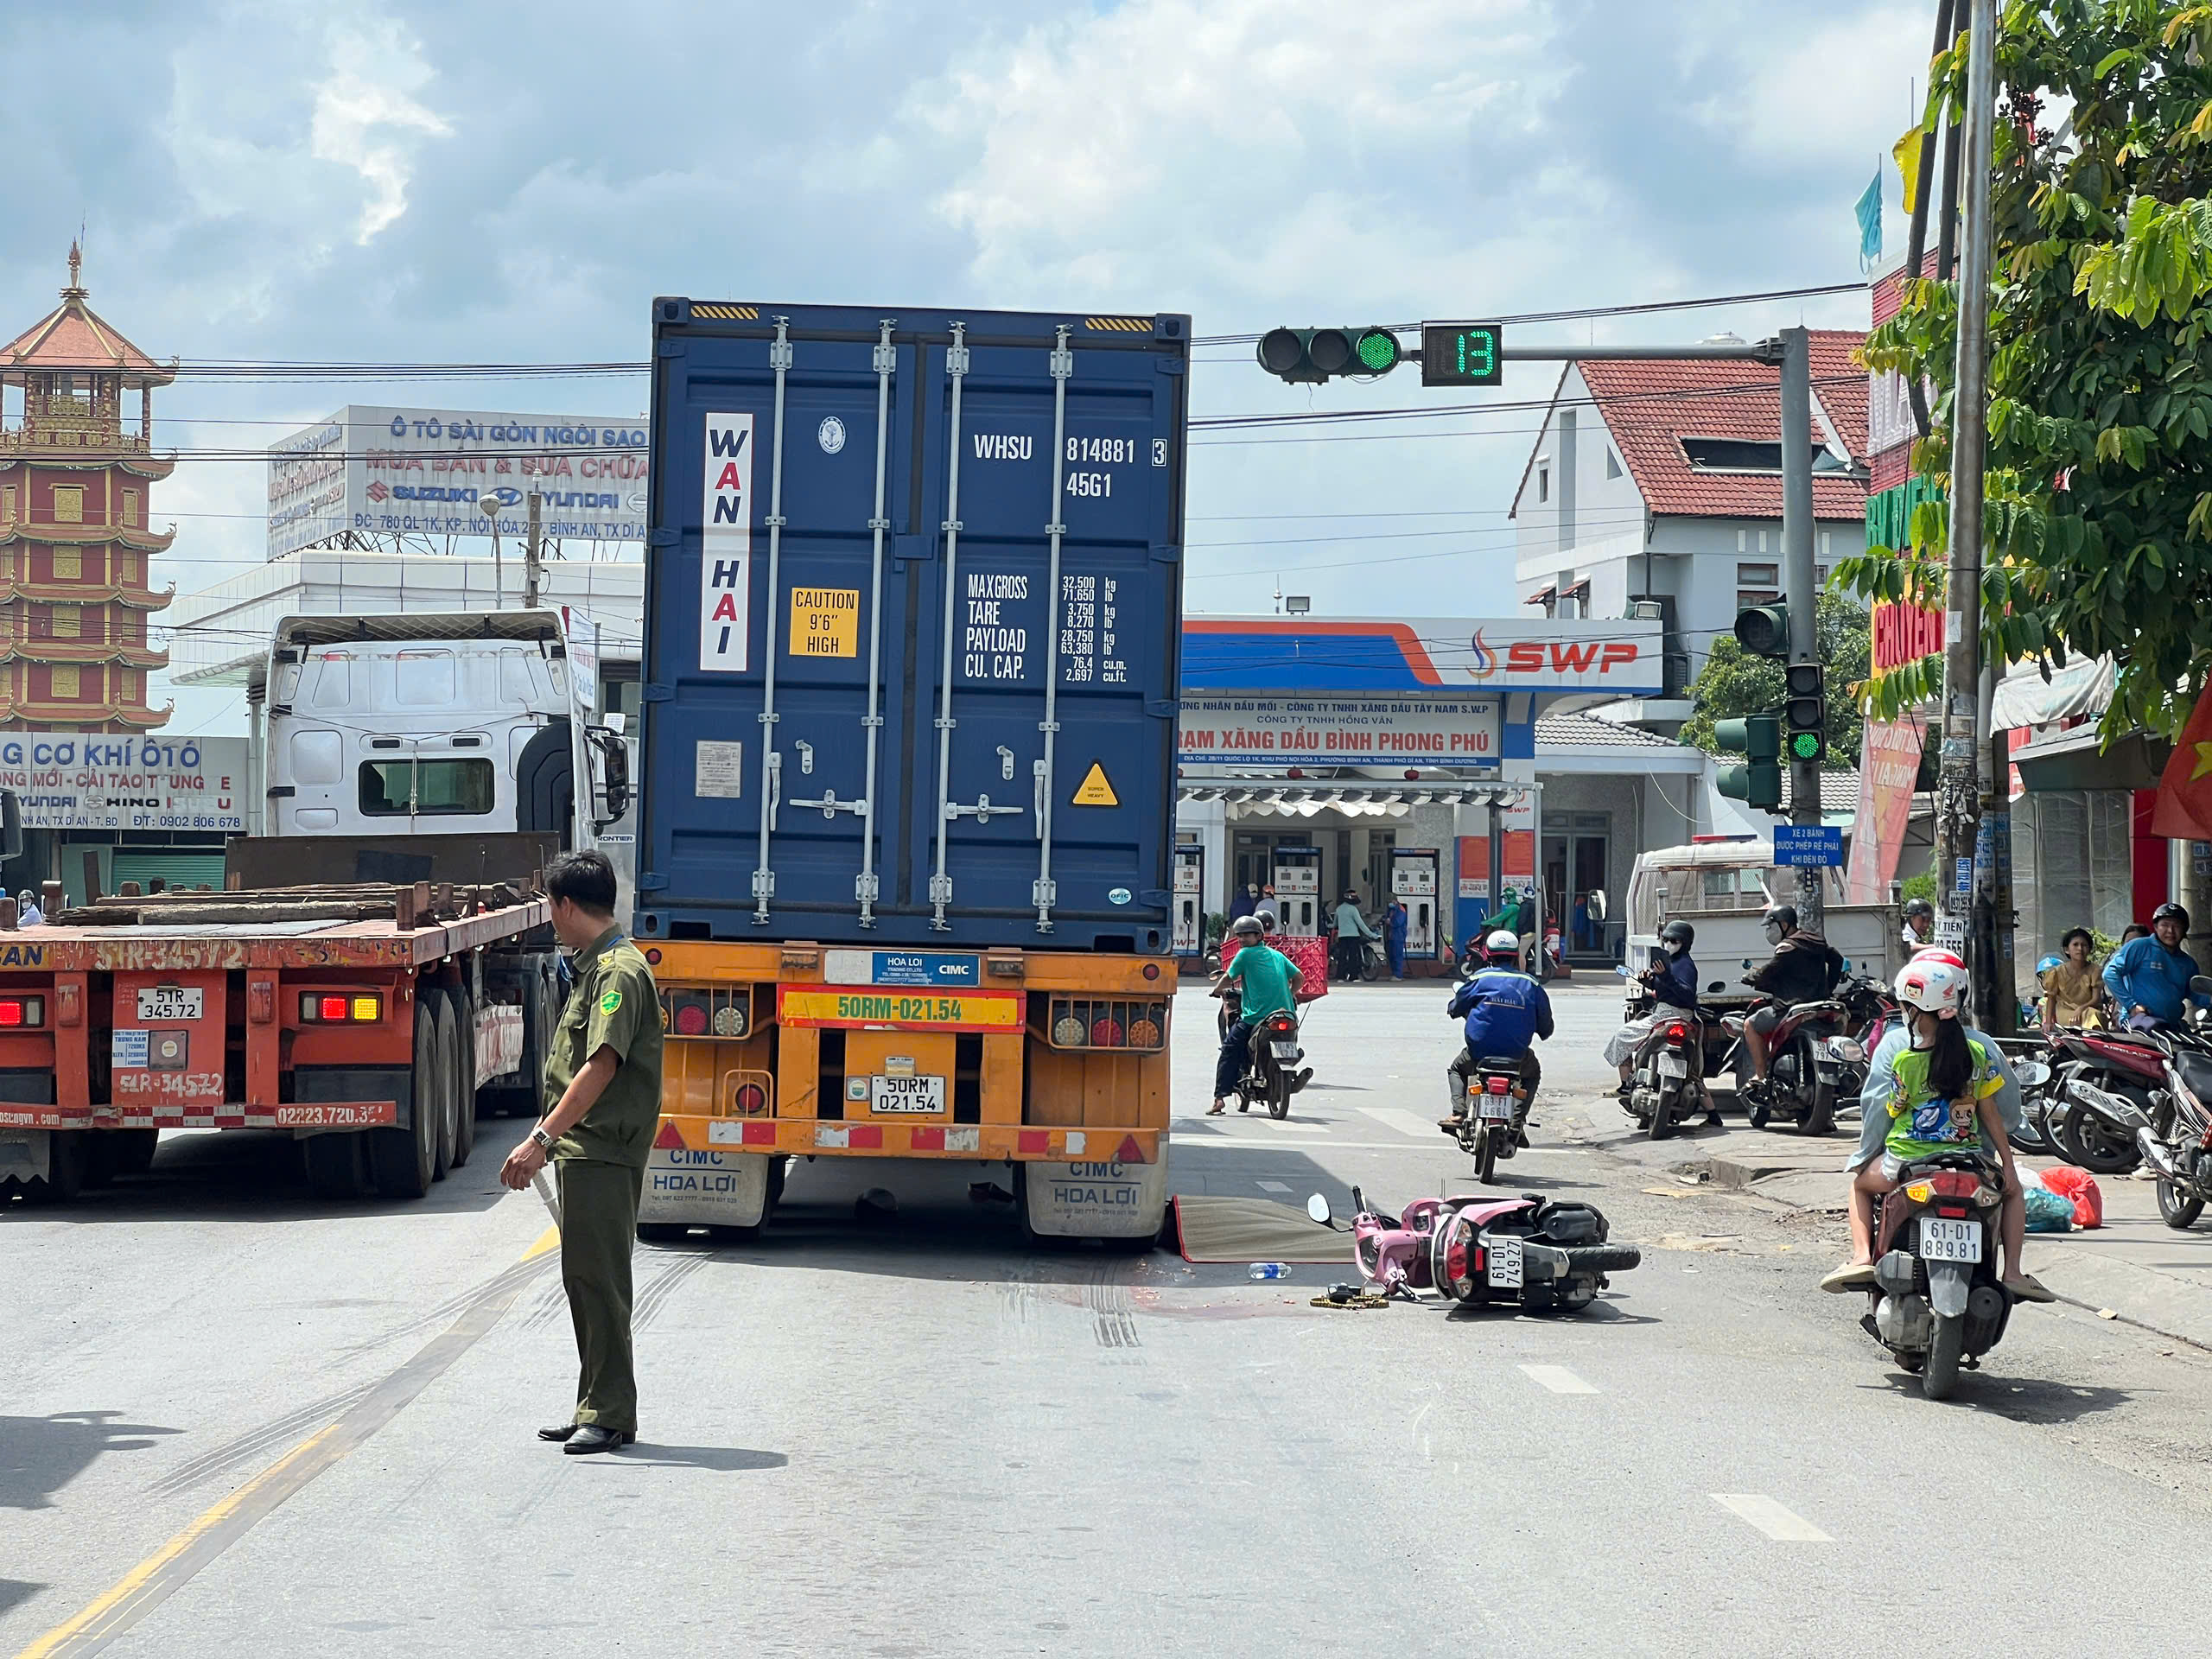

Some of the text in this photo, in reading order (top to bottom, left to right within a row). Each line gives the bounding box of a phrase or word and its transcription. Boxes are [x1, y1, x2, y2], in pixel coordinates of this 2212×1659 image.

[1457, 330, 1494, 377] 13
[391, 415, 646, 446] Ô TÔ SÀI GÒN NGÔI SAO
[973, 434, 1166, 465] WHSU 814881 3
[366, 448, 424, 470] MUA
[495, 454, 512, 474] &
[709, 428, 749, 524] WAN
[1066, 472, 1112, 499] 45G1
[392, 486, 620, 509] SUZUKI YUNDAI
[379, 516, 399, 529] 780
[404, 516, 420, 530] QL
[424, 516, 442, 532] 1K,
[468, 515, 490, 534] NỘI
[550, 518, 577, 536] BÌNH
[582, 523, 601, 538] AN,
[606, 523, 620, 537] TX
[622, 521, 634, 537] DĨ
[1062, 575, 1116, 592] 32,500 kg
[795, 589, 855, 610] CAUTION
[1062, 588, 1113, 602] 71,650 lb
[711, 559, 739, 655] HAI
[968, 601, 1001, 626] TARE
[1067, 603, 1116, 619] 3,750 kg
[1067, 615, 1113, 629] 8,270 lb
[807, 635, 840, 655] HIGH
[966, 627, 1027, 653] PAYLOAD
[1061, 629, 1116, 646] 28,750 kg
[1061, 642, 1112, 656] 63,380 lb
[1506, 641, 1639, 675] SWP
[965, 653, 1025, 680] CU. CAP.
[1072, 656, 1128, 671] 76.4 cu.m.
[1065, 669, 1128, 683] 2,697 cu.ft.
[1287, 700, 1314, 712] CÔNG
[1317, 702, 1329, 712] TY
[1332, 703, 1357, 713] TNHH
[1361, 702, 1389, 713] XĂNG
[1414, 702, 1432, 714] TÂY
[1434, 704, 1459, 714] NAM
[1256, 714, 1287, 724] CÔNG
[1221, 725, 1489, 752] XĂNG DẦU BÌNH PHONG PHÚ
[3, 742, 23, 765] G
[34, 741, 75, 766] CƠ
[84, 739, 134, 766] KHÍ
[33, 767, 143, 791] MỚI CẢI TẠO
[17, 795, 160, 809] YUNDAI HINO
[53, 816, 64, 825] TX
[66, 814, 75, 826] DĨ
[76, 816, 89, 826] AN
[95, 817, 104, 827] T.
[105, 817, 118, 827] BD
[133, 815, 156, 828] ĐT:
[160, 816, 189, 828] 0902
[193, 816, 215, 829] 806
[219, 816, 241, 829] 678
[1792, 829, 1806, 837] XE 2
[1795, 839, 1812, 850] PHÉP
[1791, 855, 1802, 864] KHI
[1802, 853, 1817, 864] ĐÈN
[887, 957, 923, 967] HOA LOI
[938, 964, 969, 975] CIMC
[156, 989, 184, 1003] 51R
[144, 1004, 195, 1018] 345.72
[836, 996, 963, 1022] 50RM-021.54
[887, 1077, 929, 1093] 50RM
[880, 1094, 936, 1110] 021.54
[670, 1149, 723, 1165] CIMC
[1070, 1161, 1123, 1178] CIMC
[654, 1174, 736, 1194] HOA LỢI
[1054, 1186, 1136, 1207] HOA LỢI
[1931, 1222, 1971, 1241] 61-D1
[1924, 1239, 1977, 1260] 889.81
[1491, 1245, 1506, 1279] 61-D1
[1506, 1240, 1521, 1285] 749.27
